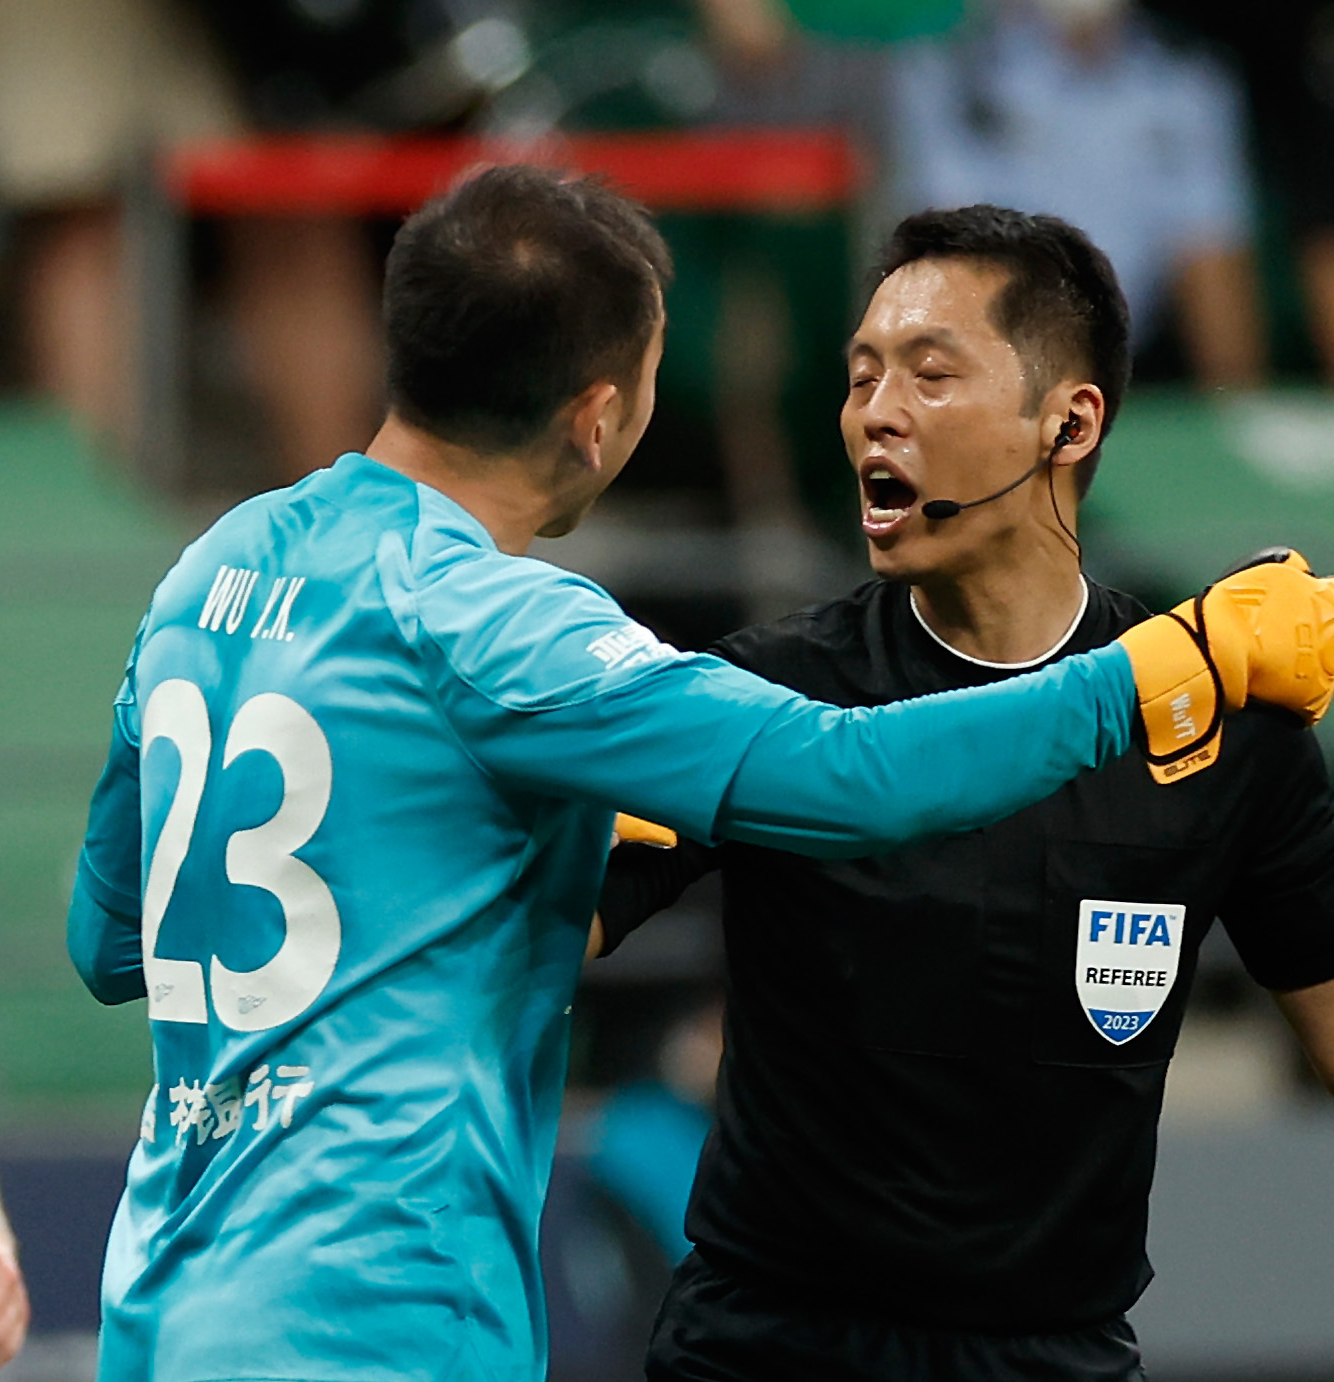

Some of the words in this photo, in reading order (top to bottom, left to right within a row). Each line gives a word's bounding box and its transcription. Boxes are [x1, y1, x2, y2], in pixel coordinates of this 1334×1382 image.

[198, 565, 259, 635] WU
[141, 678, 342, 1032] 23
[1089, 910, 1171, 946] FIFA
[1085, 967, 1167, 987] REFEREE
[1102, 1014, 1140, 1031] 2023
